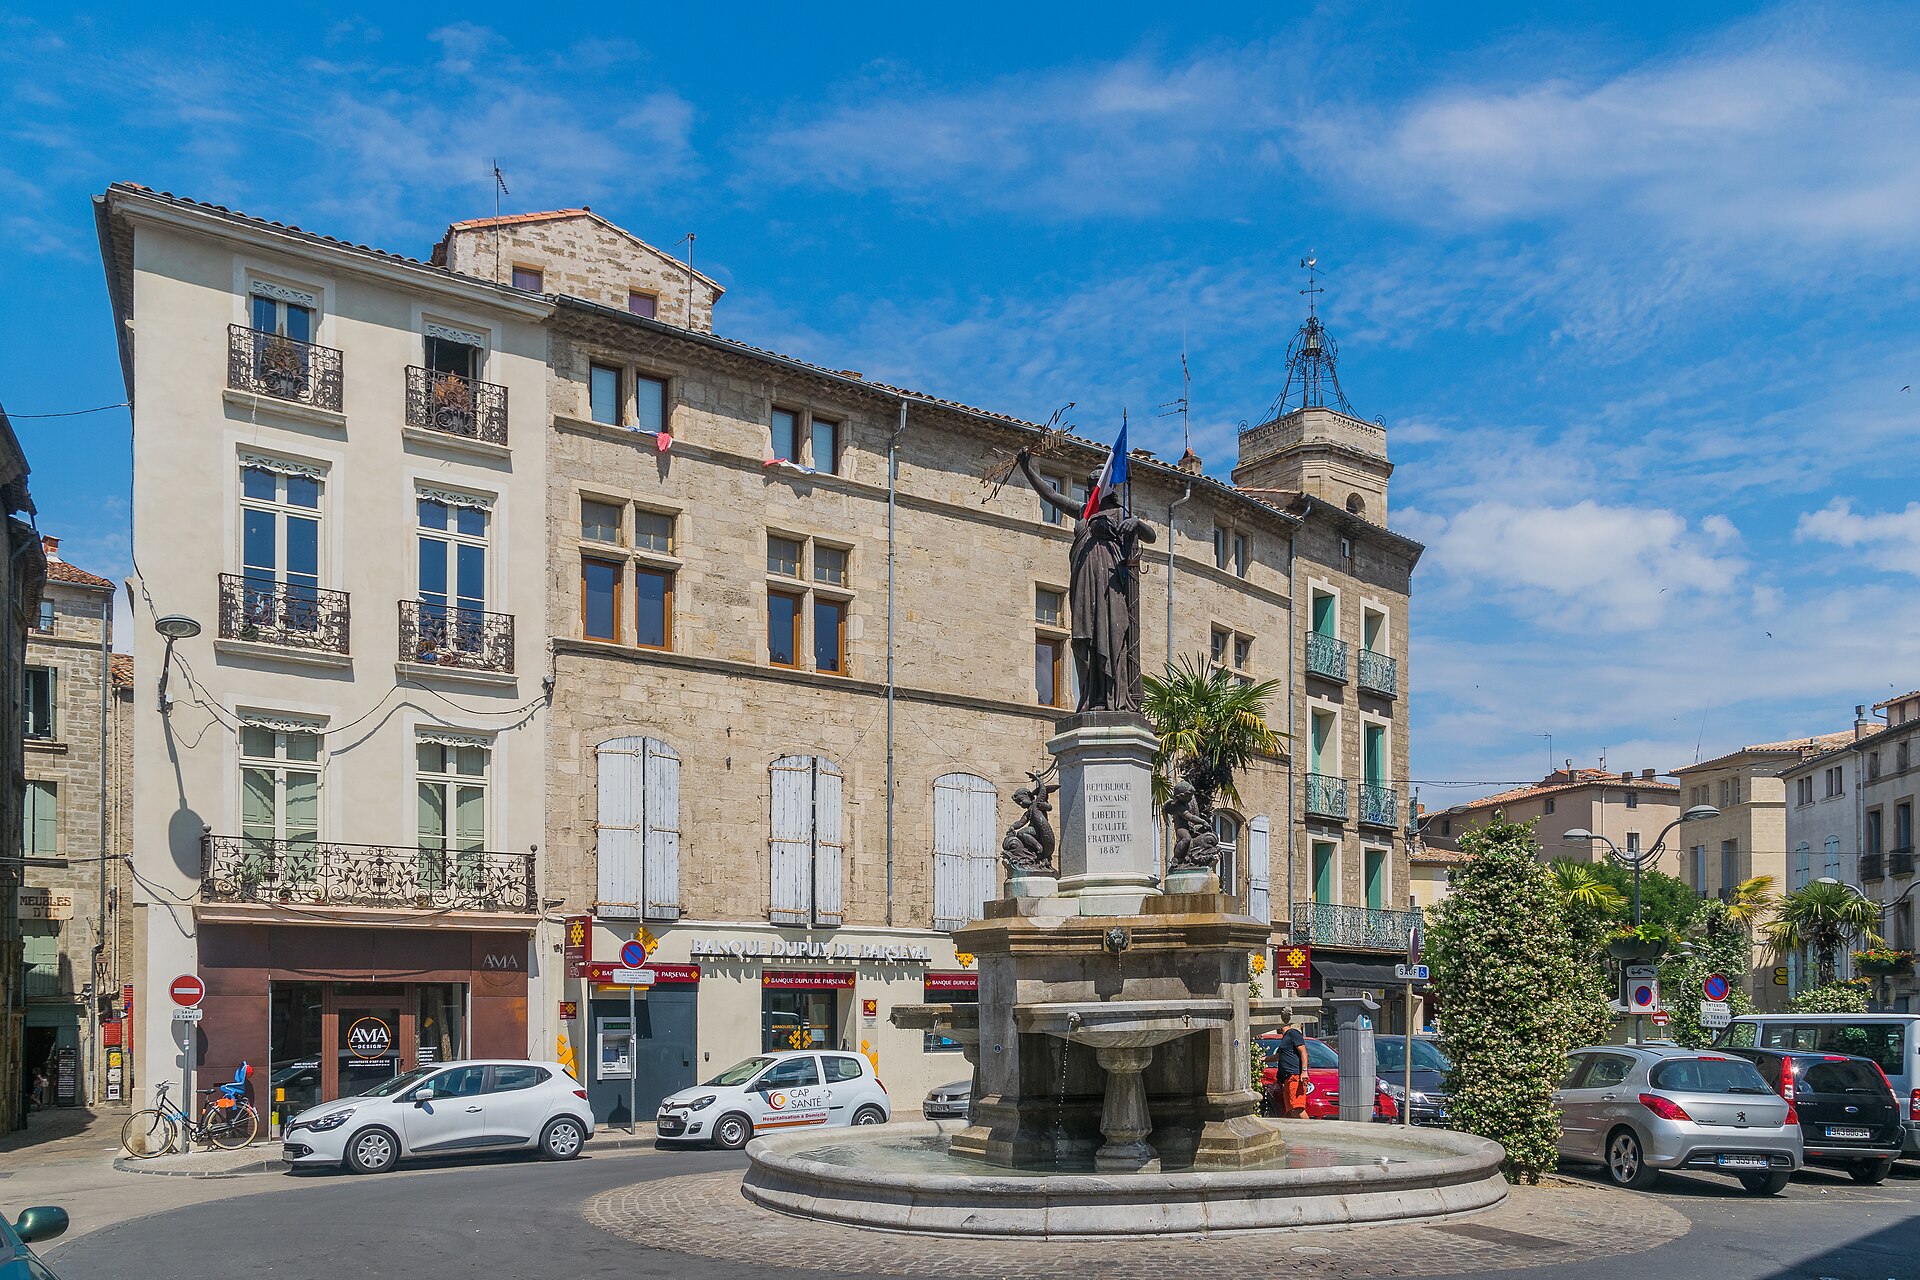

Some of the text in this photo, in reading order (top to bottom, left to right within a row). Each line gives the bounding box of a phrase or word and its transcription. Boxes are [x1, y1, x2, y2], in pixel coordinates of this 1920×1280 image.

[1100, 846, 1120, 855] 1887
[20, 896, 71, 906] MEUBLES
[691, 939, 767, 960] BANQUE
[834, 943, 858, 956] DE
[861, 944, 928, 963] PARSEVAL
[482, 953, 519, 969] AMA
[661, 971, 689, 979] PARSEVAL
[1400, 968, 1418, 976] SAUF
[770, 977, 793, 985] BANQUE
[350, 1027, 389, 1043] AMA
[790, 1088, 809, 1098] CAP
[791, 1096, 821, 1109] SANTÉ
[762, 1112, 800, 1122] Hospitalisation
